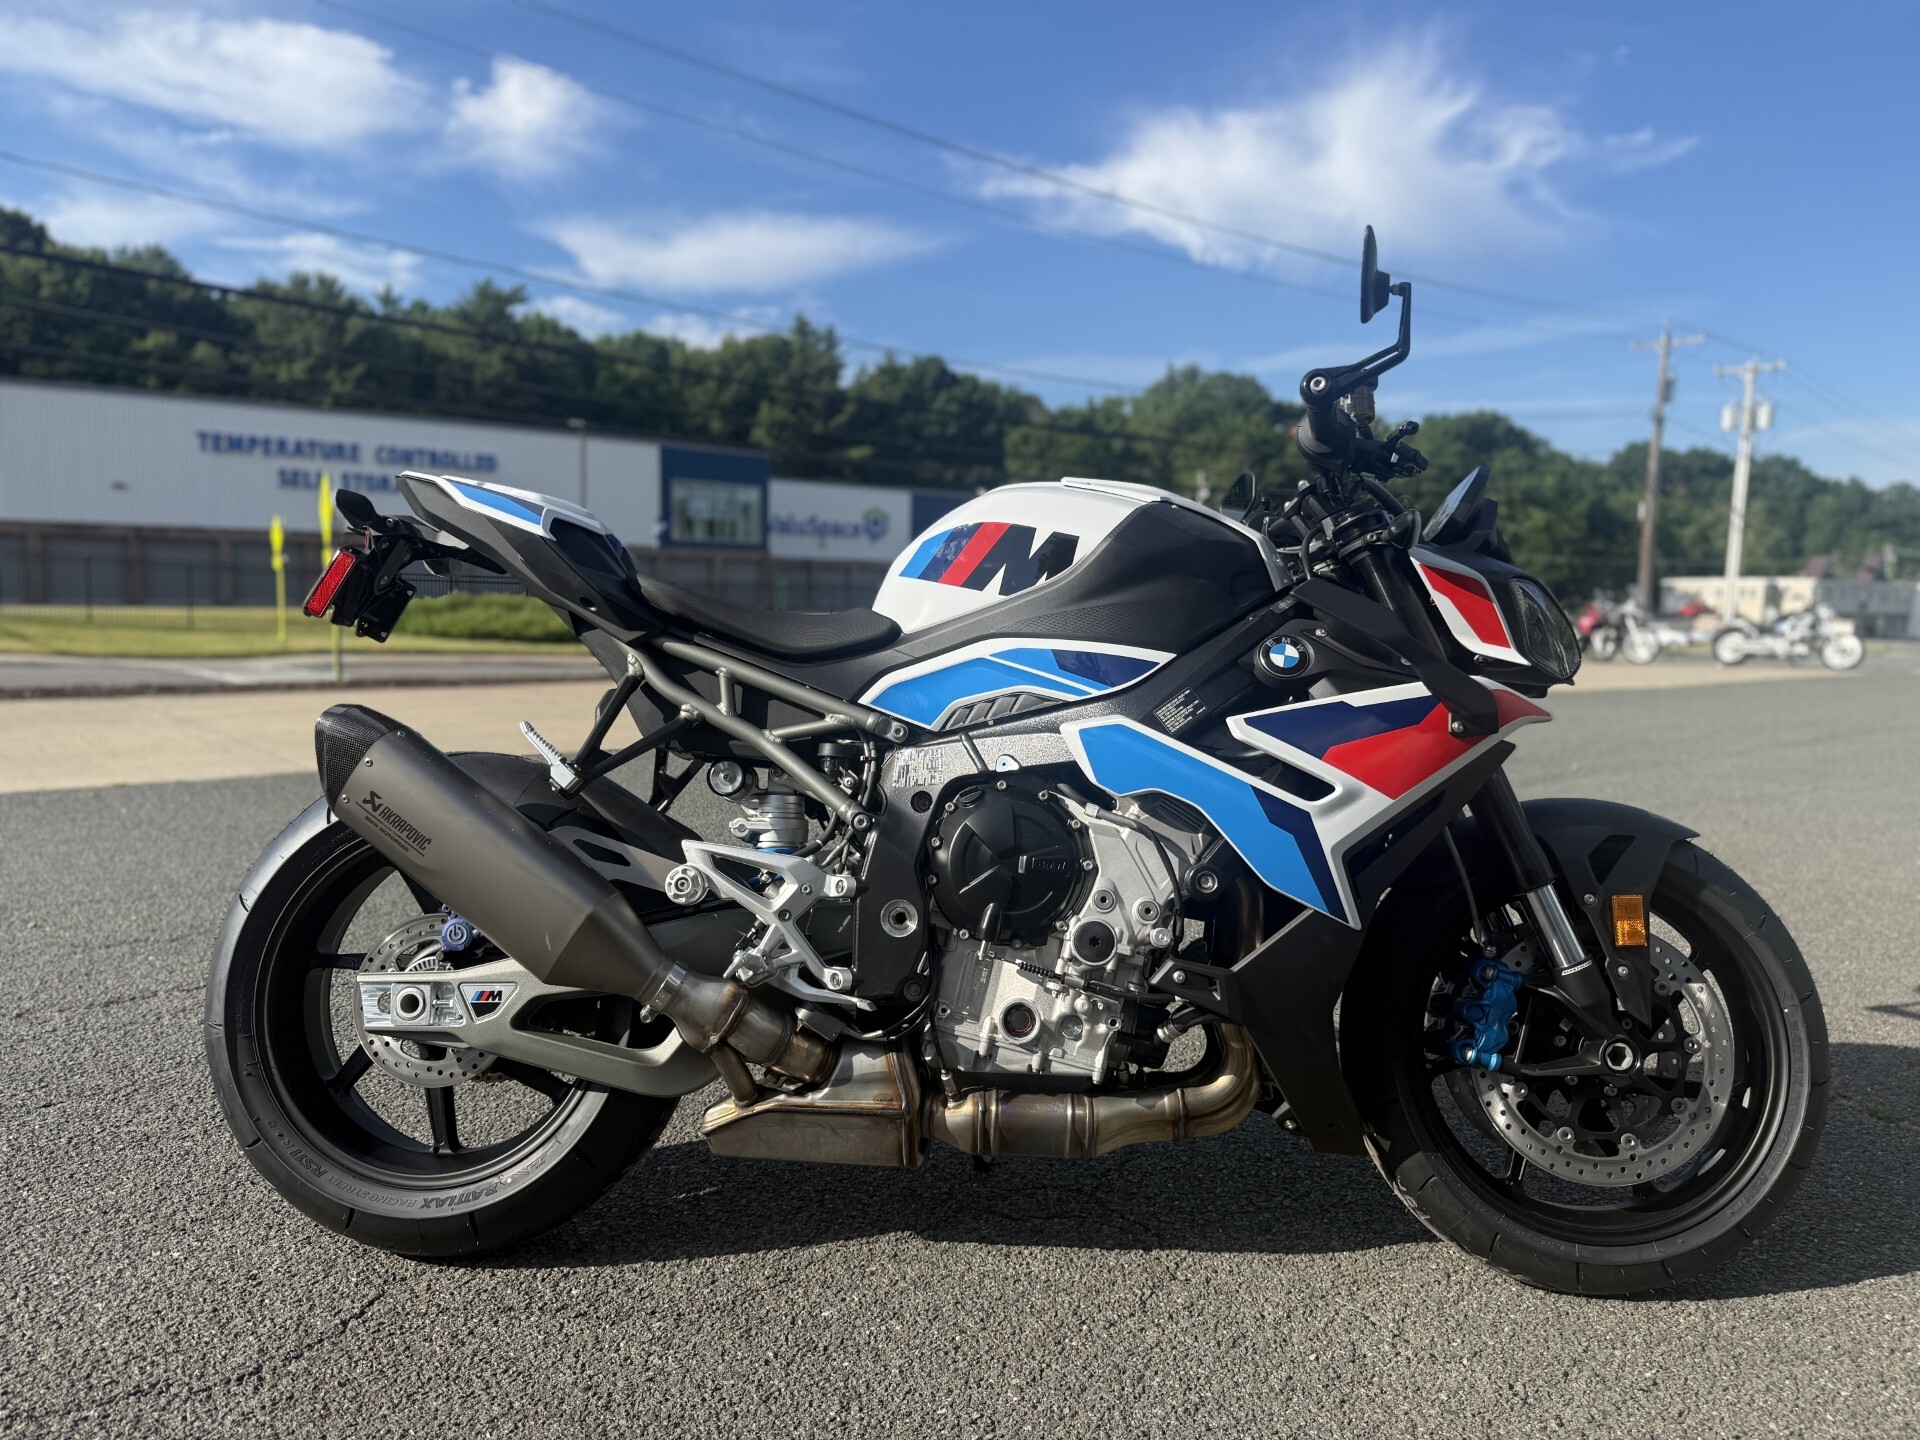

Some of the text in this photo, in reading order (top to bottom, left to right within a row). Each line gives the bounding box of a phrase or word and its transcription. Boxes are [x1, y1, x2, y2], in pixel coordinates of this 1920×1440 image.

[197, 431, 498, 472] TEMPERATURE CONTROLLED
[1266, 637, 1306, 652] BMW
[364, 815, 379, 829] BMW
[378, 826, 410, 853] MOTORRAD
[419, 1183, 499, 1210] BATTLAX
